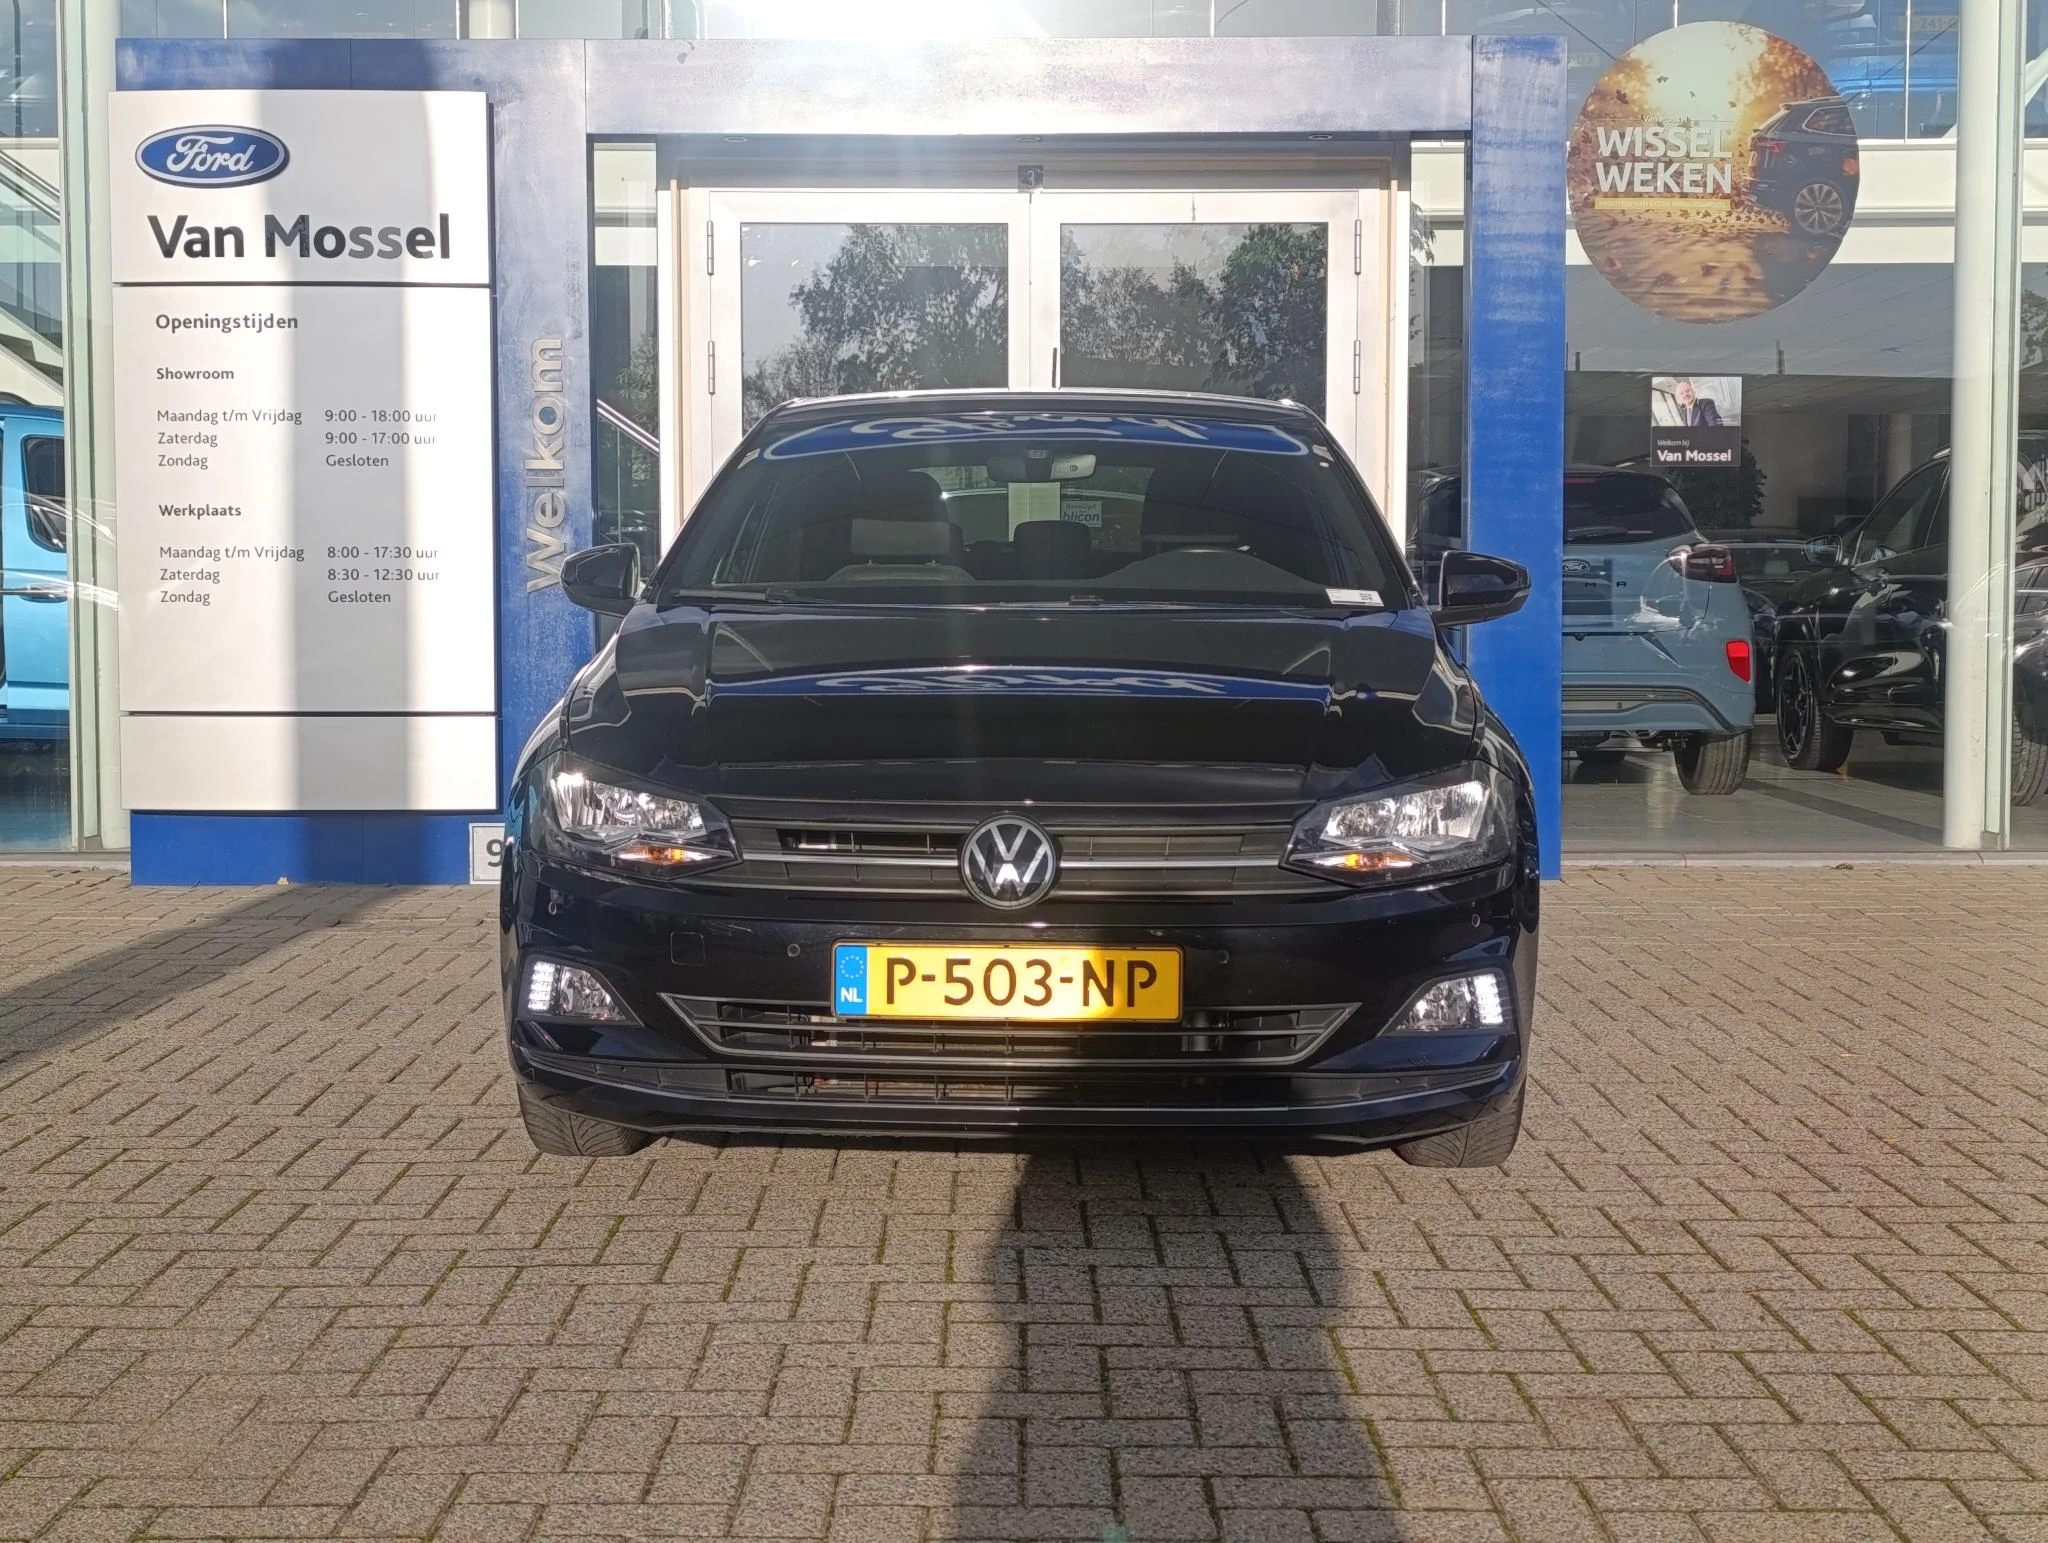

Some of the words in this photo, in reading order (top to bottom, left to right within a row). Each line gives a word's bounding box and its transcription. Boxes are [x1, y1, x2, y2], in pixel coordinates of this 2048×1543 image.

[1597, 126, 1733, 158] WISSEL
[166, 135, 256, 172] Ford
[1596, 162, 1732, 194] WEKEN
[147, 214, 246, 259] Van
[263, 213, 451, 259] Mossel
[155, 313, 299, 334] Openingstijden
[156, 367, 235, 381] Showroom
[156, 409, 219, 426] Maandag
[222, 409, 248, 423] t/m
[251, 409, 303, 426] Vrijdag
[324, 409, 357, 423] 9:00
[371, 409, 411, 423] 18:00
[414, 412, 437, 423] uur
[157, 432, 219, 448] Zaterdag
[324, 431, 358, 445] 9:00
[371, 431, 411, 445] 17:00
[414, 435, 437, 445] uur
[158, 454, 209, 470] Zondag
[325, 454, 390, 468] Gesloten
[1657, 450, 1682, 462] Van
[1686, 449, 1732, 462] Mossel
[524, 338, 566, 594] Welkom
[159, 504, 242, 520] Werkplaats
[159, 546, 221, 562] Maandag
[225, 546, 251, 560] t/m
[254, 546, 305, 562] Vrijdag
[327, 546, 360, 560] 8:00
[373, 546, 412, 560] 17:30
[416, 549, 439, 560] uur
[159, 568, 221, 584] Zaterdag
[327, 568, 360, 581] 8:30
[373, 568, 413, 581] 12:30
[417, 571, 440, 581] uur
[160, 590, 211, 606] Zondag
[327, 590, 391, 604] Gesloten
[486, 838, 503, 868] 9
[886, 957, 1158, 1008] P-503-NP
[840, 986, 863, 1003] NL
